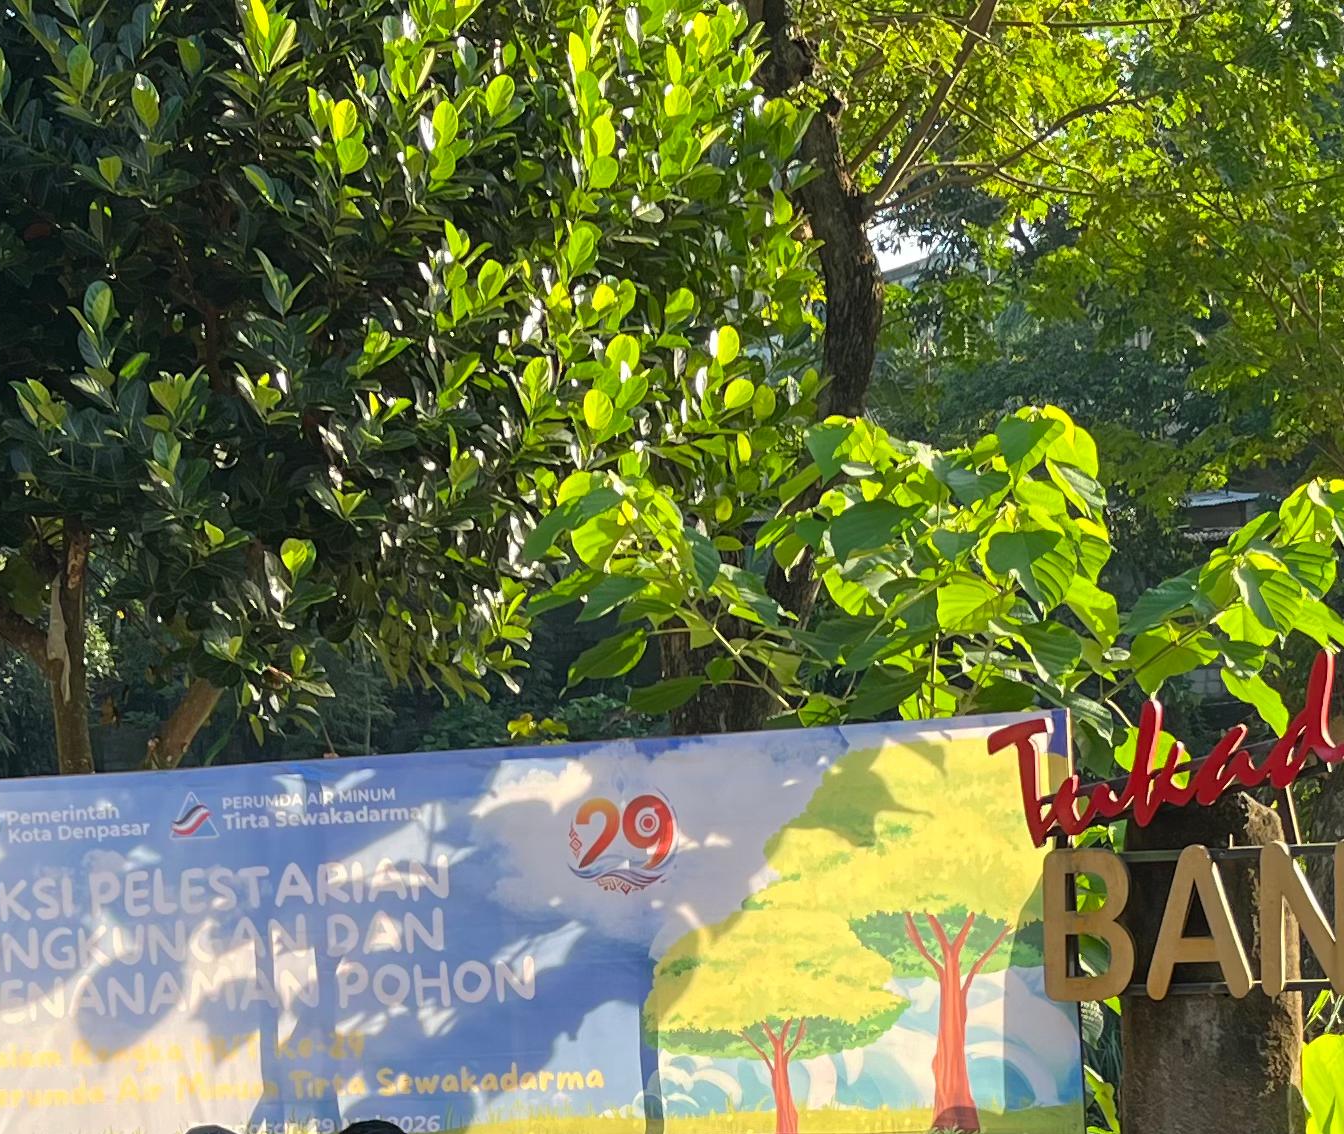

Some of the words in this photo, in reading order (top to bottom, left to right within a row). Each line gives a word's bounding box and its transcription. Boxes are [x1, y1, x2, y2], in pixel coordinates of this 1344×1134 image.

[7, 804, 120, 826] Pemerintah
[222, 792, 303, 810] PERUMDA
[307, 791, 334, 806] AIR
[339, 788, 396, 803] MINUM
[222, 811, 269, 830] Tirta
[275, 805, 424, 828] Sewakadarma
[8, 826, 52, 844] Kota
[58, 821, 151, 842] Denpasar
[575, 794, 674, 870] 29
[89, 853, 449, 922] PELESTARIAN
[326, 907, 444, 955] DAN
[336, 954, 535, 1009] POHON
[288, 1069, 367, 1099] Tirta
[376, 1061, 605, 1097] Sewakadarma
